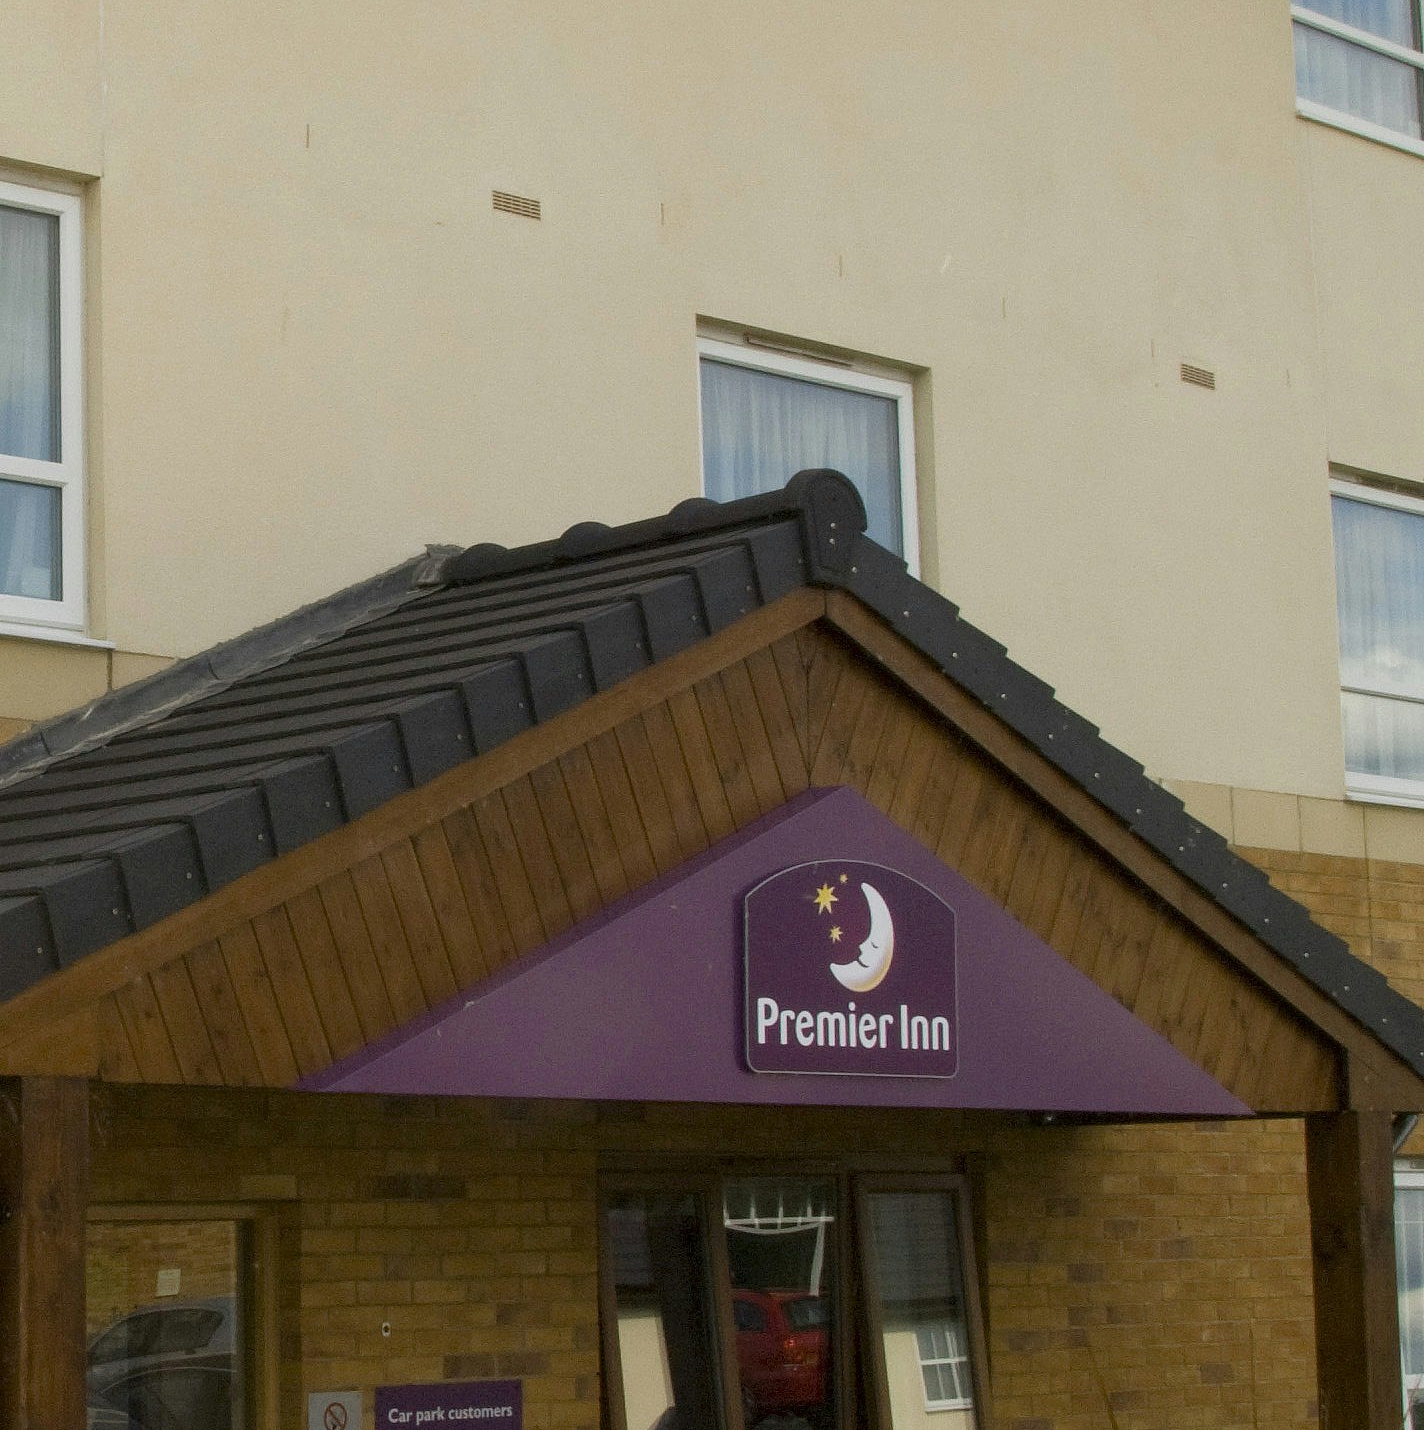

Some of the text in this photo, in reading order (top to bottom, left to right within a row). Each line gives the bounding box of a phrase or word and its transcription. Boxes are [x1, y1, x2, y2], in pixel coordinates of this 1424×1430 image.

[757, 997, 950, 1051] Premier Inn
[388, 1405, 513, 1426] Car park customers
